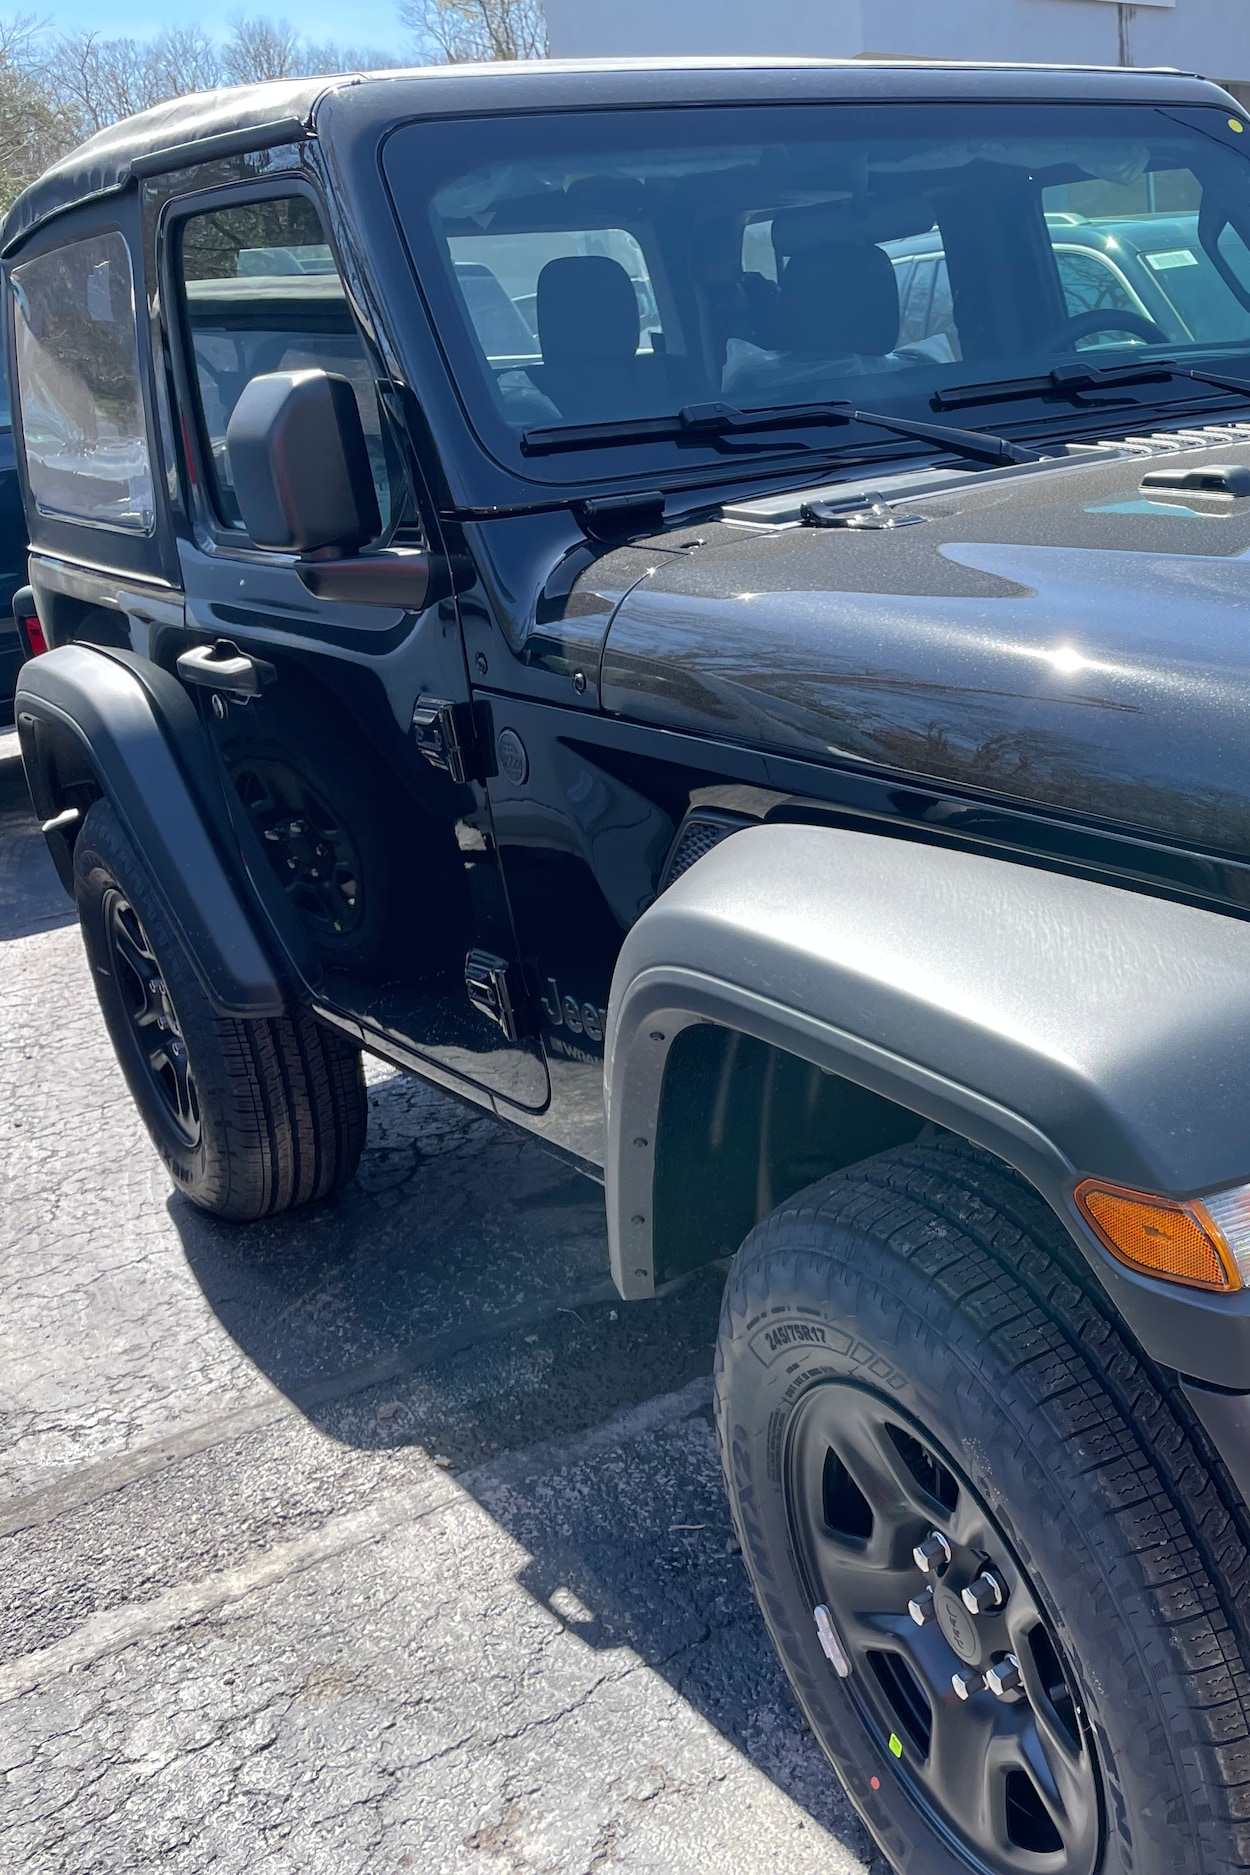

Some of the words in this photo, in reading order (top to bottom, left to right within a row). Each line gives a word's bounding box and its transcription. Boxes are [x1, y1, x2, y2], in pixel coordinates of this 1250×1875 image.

[561, 1041, 605, 1066] WRAN
[764, 1323, 828, 1352] 245/75R17
[945, 1602, 965, 1651] Jeep
